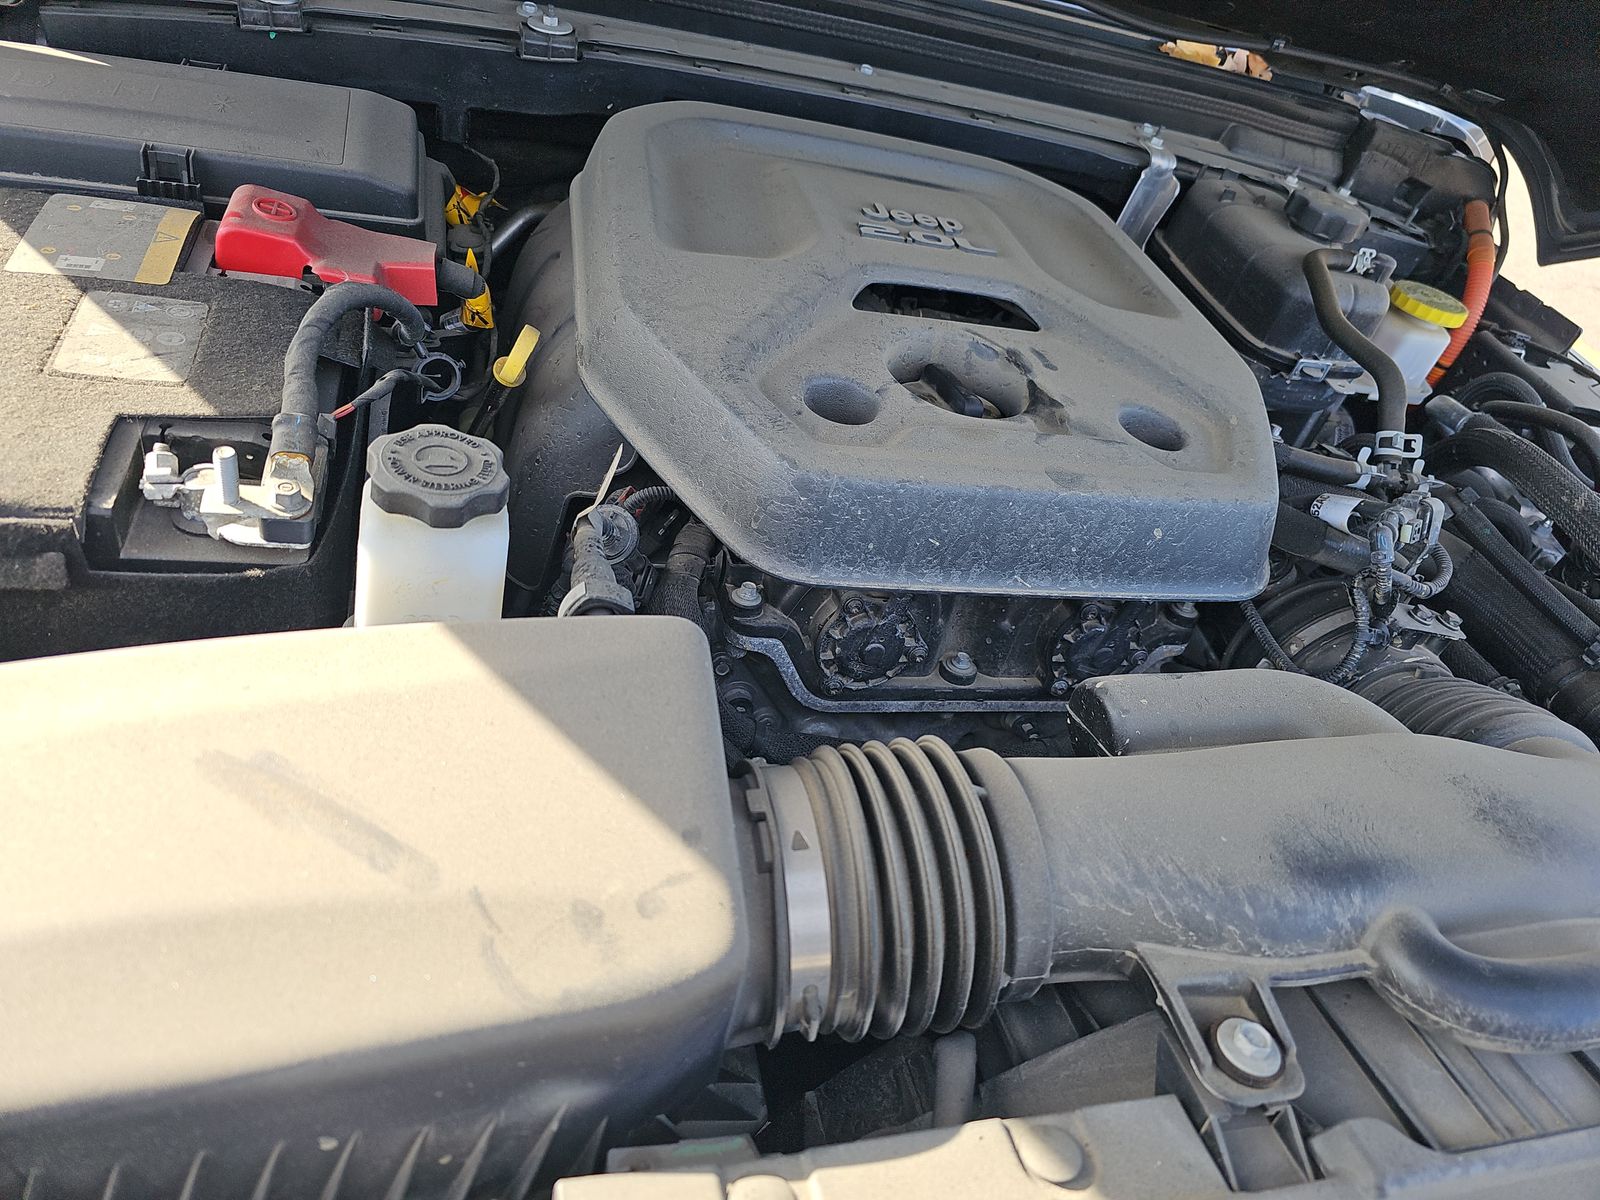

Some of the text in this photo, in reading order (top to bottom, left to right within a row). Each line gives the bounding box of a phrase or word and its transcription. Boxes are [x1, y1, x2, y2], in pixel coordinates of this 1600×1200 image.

[861, 202, 963, 236] Jeep
[857, 222, 998, 257] 2.0L
[393, 430, 480, 448] USE APPROVED
